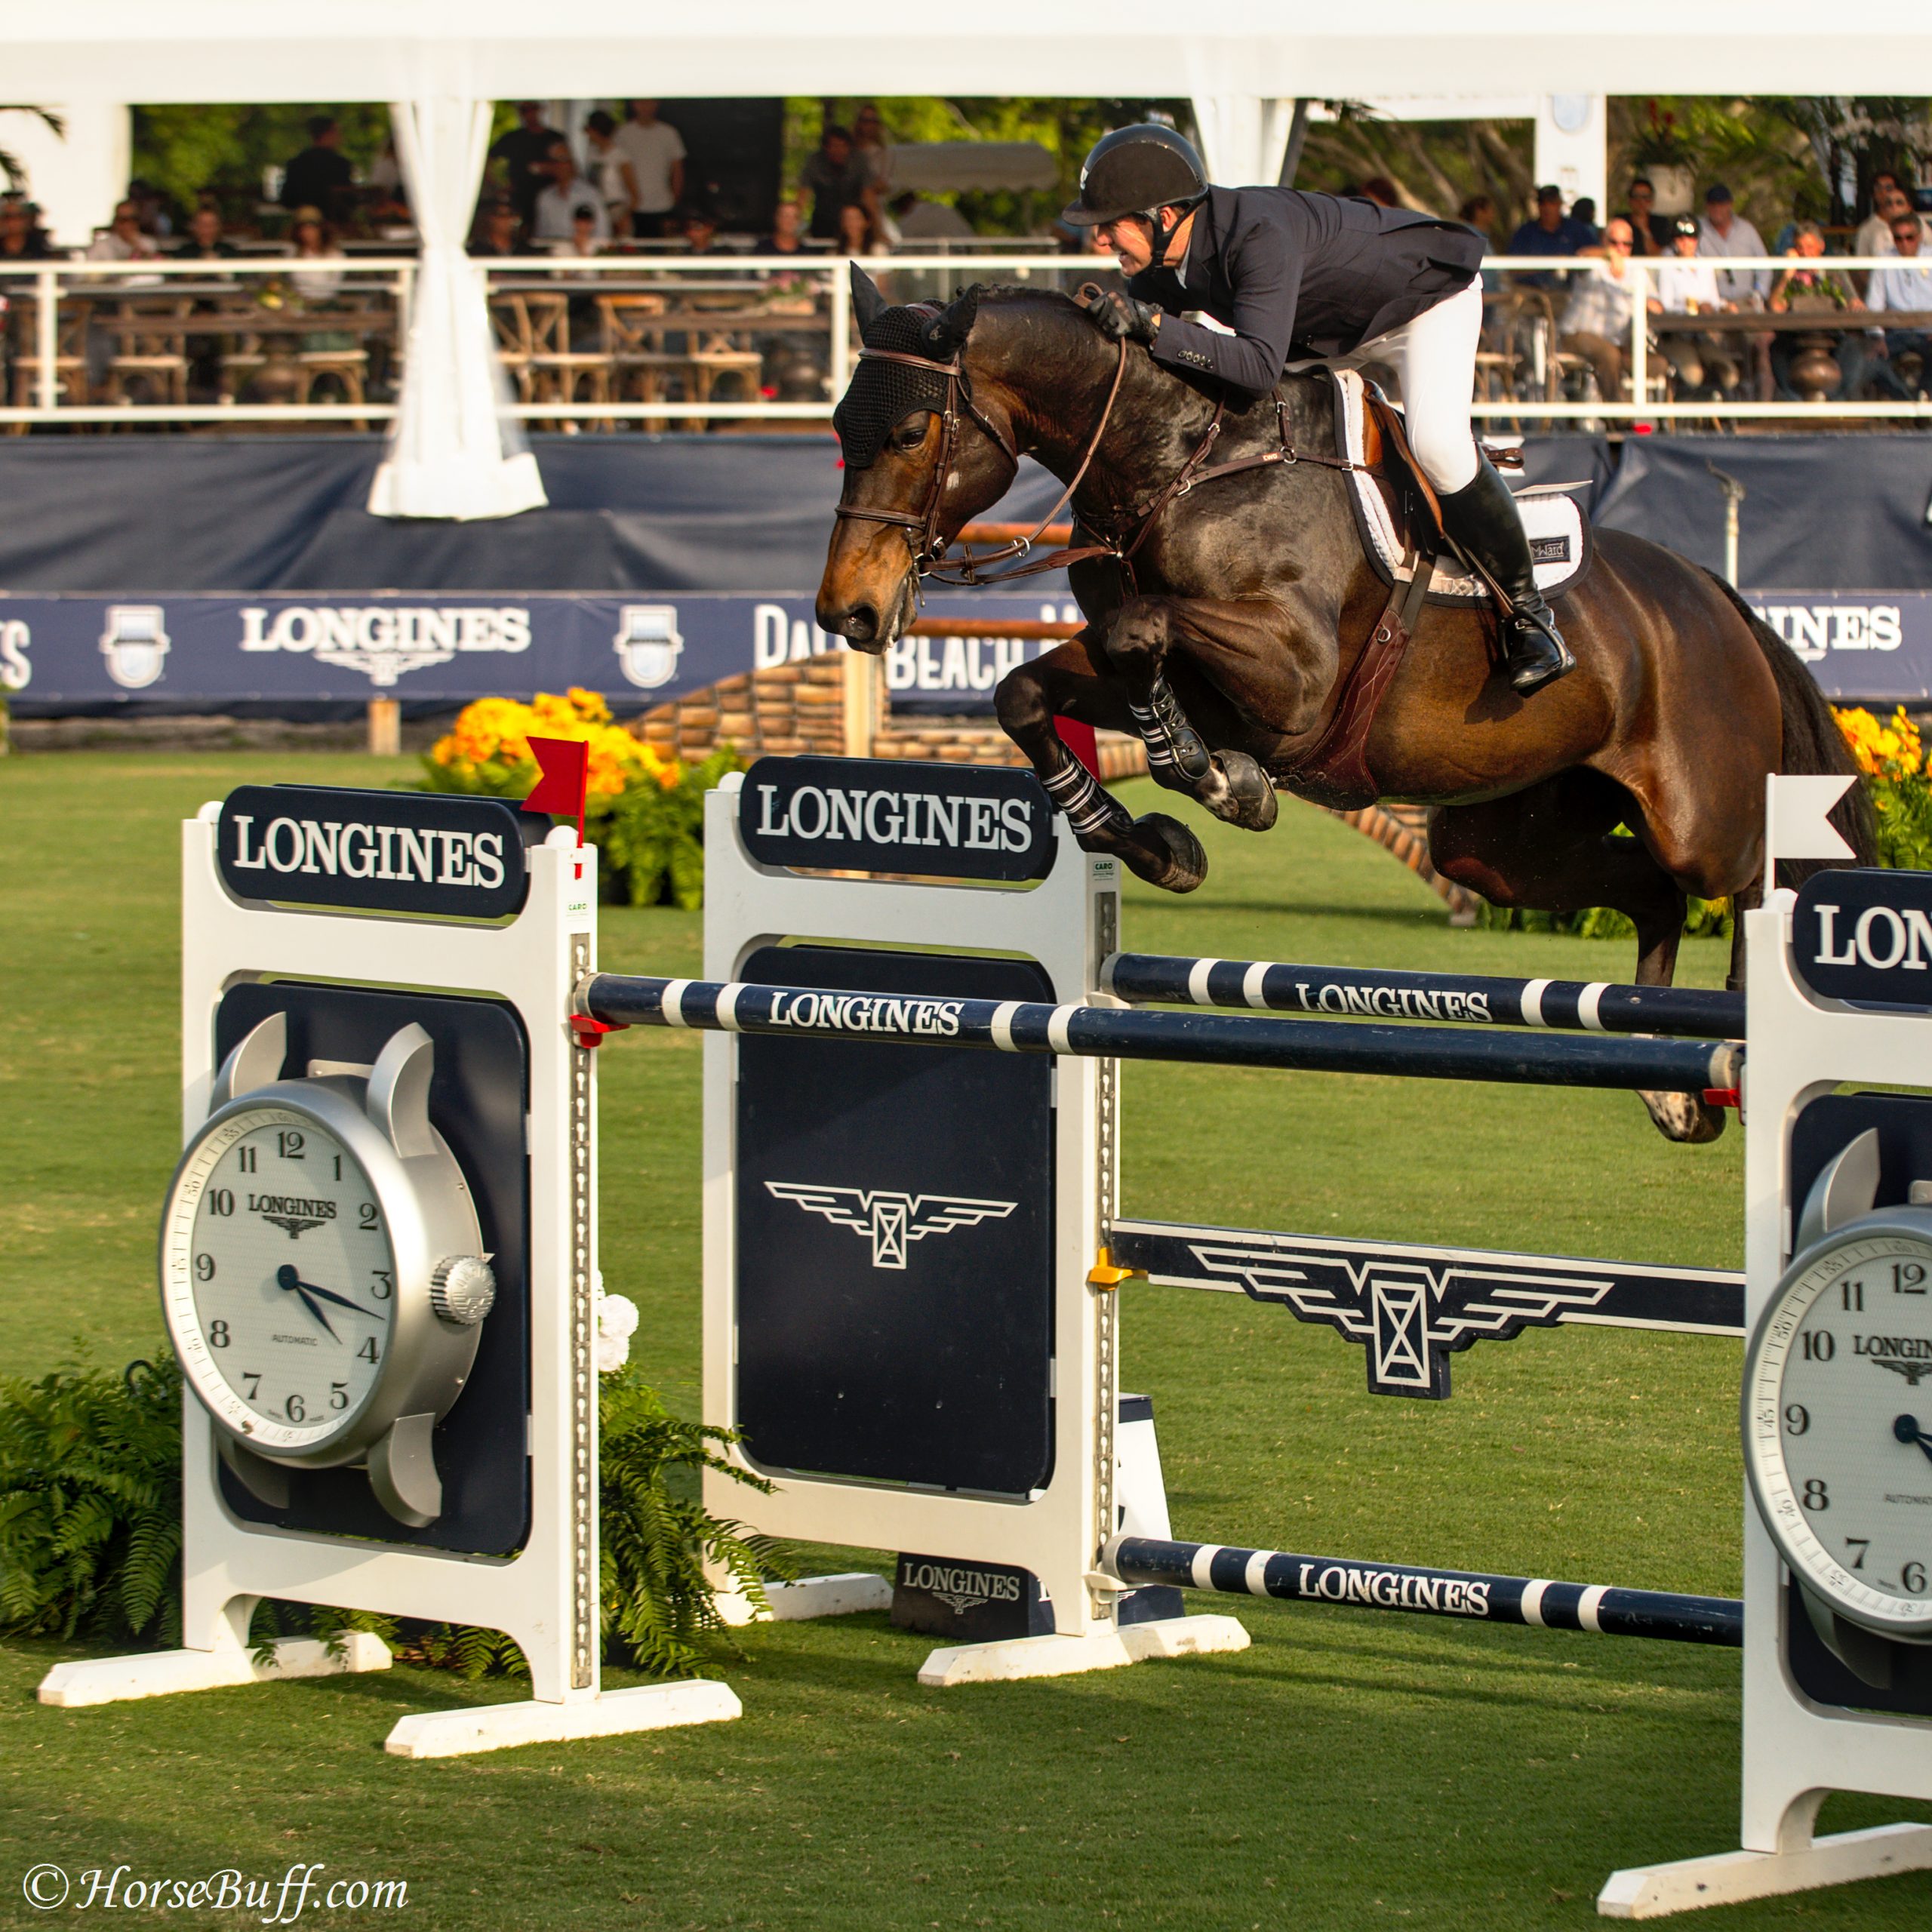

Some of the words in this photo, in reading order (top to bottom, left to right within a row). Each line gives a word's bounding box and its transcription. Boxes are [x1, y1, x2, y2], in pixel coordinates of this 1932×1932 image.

[239, 607, 532, 653] LONGINES
[1752, 605, 1903, 651] INES
[756, 784, 1032, 854] LONGINES
[232, 815, 505, 889] LONGINES
[769, 992, 964, 1036] LONGINES
[1295, 983, 1494, 1023] LONGINES
[238, 1146, 257, 1173] 11
[278, 1131, 304, 1159] 12
[334, 1155, 342, 1181] 1
[208, 1189, 235, 1216] 10
[248, 1194, 337, 1219] LONGINES
[359, 1203, 378, 1230] 2
[196, 1254, 215, 1281] 9
[1892, 1263, 1927, 1294] 12
[371, 1271, 392, 1300] 3
[1841, 1281, 1864, 1312] 11
[210, 1320, 230, 1348] 8
[272, 1334, 318, 1346] AUTOMATIC
[1801, 1330, 1835, 1361] 10
[357, 1337, 380, 1364] 4
[242, 1372, 262, 1400] 7
[331, 1382, 349, 1409] 5
[286, 1395, 305, 1423] 6
[1786, 1404, 1810, 1435] 9
[1804, 1479, 1829, 1511] 8
[1846, 1537, 1871, 1569] 7
[903, 1562, 1020, 1601] LONGINES
[1299, 1564, 1491, 1616] LONGINES
[1901, 1561, 1927, 1594] 6
